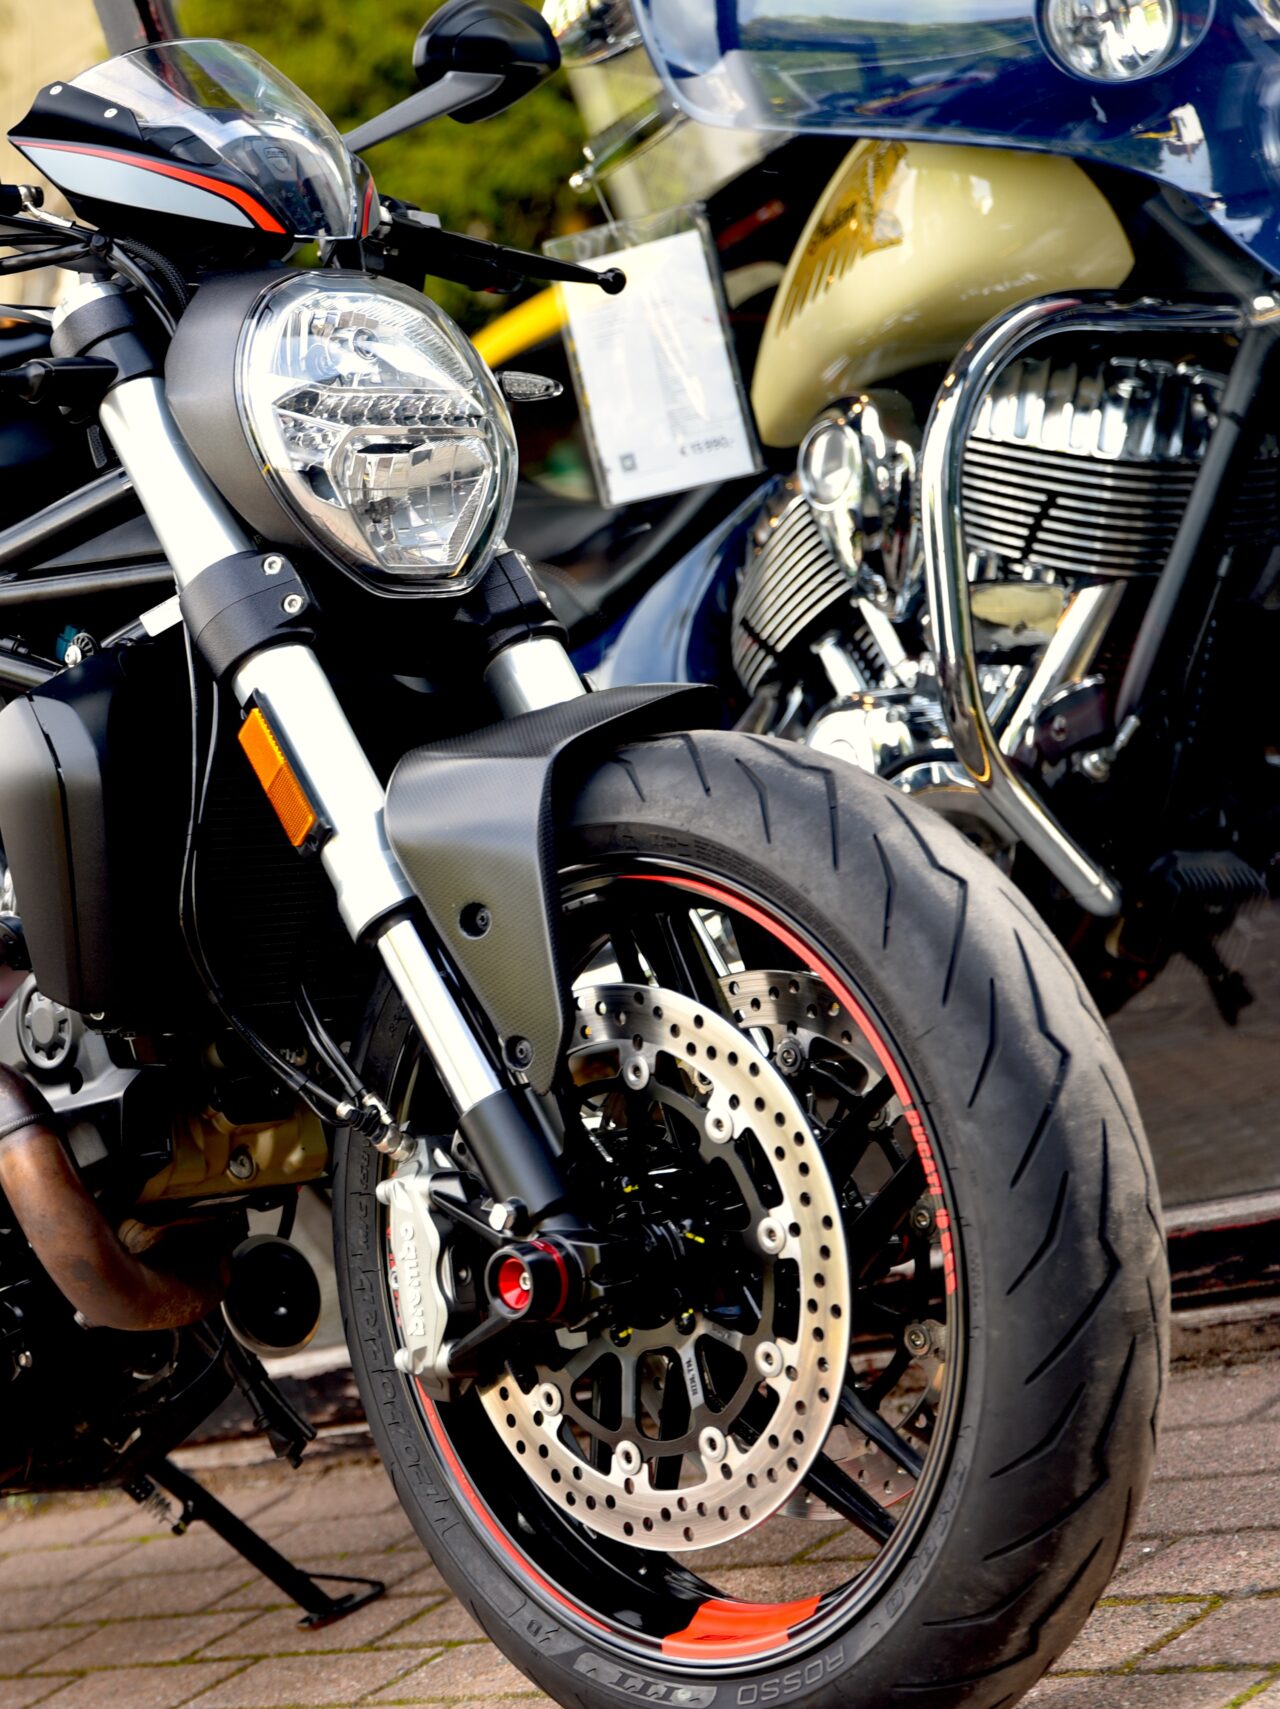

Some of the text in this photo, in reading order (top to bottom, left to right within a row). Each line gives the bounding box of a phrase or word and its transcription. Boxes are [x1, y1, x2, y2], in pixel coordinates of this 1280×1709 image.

[904, 1109, 943, 1196] DUCATI
[399, 1221, 426, 1337] brembo
[736, 1644, 845, 1705] ROSSO
